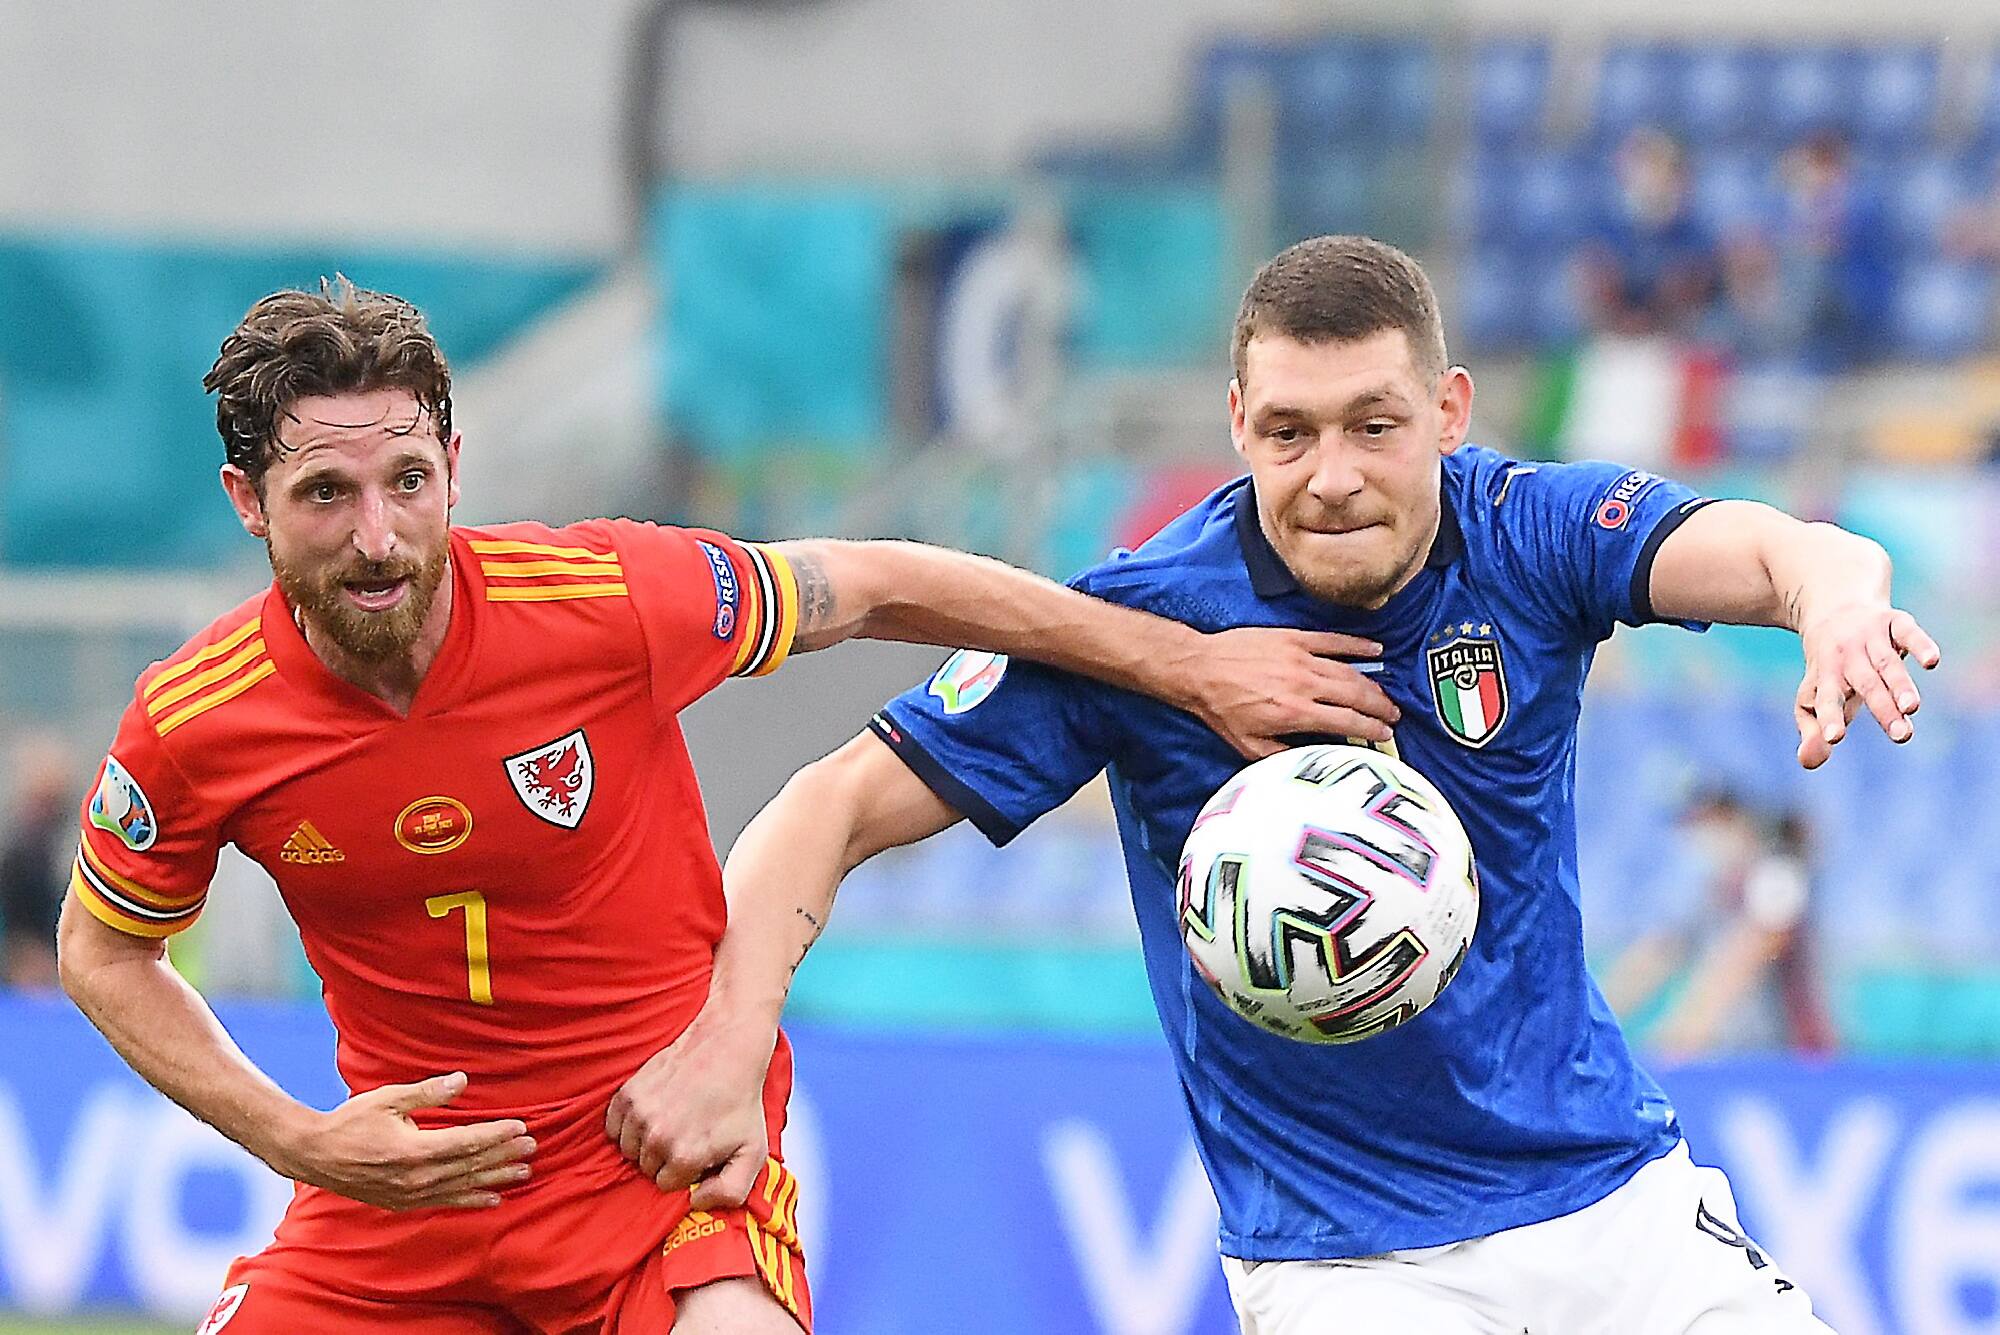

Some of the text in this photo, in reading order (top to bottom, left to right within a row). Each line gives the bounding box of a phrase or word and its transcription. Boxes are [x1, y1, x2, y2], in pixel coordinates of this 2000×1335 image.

[1434, 647, 1493, 672] ITALIA
[280, 849, 346, 864] adidas
[425, 890, 495, 1005] 7
[662, 1219, 726, 1257] adidas
